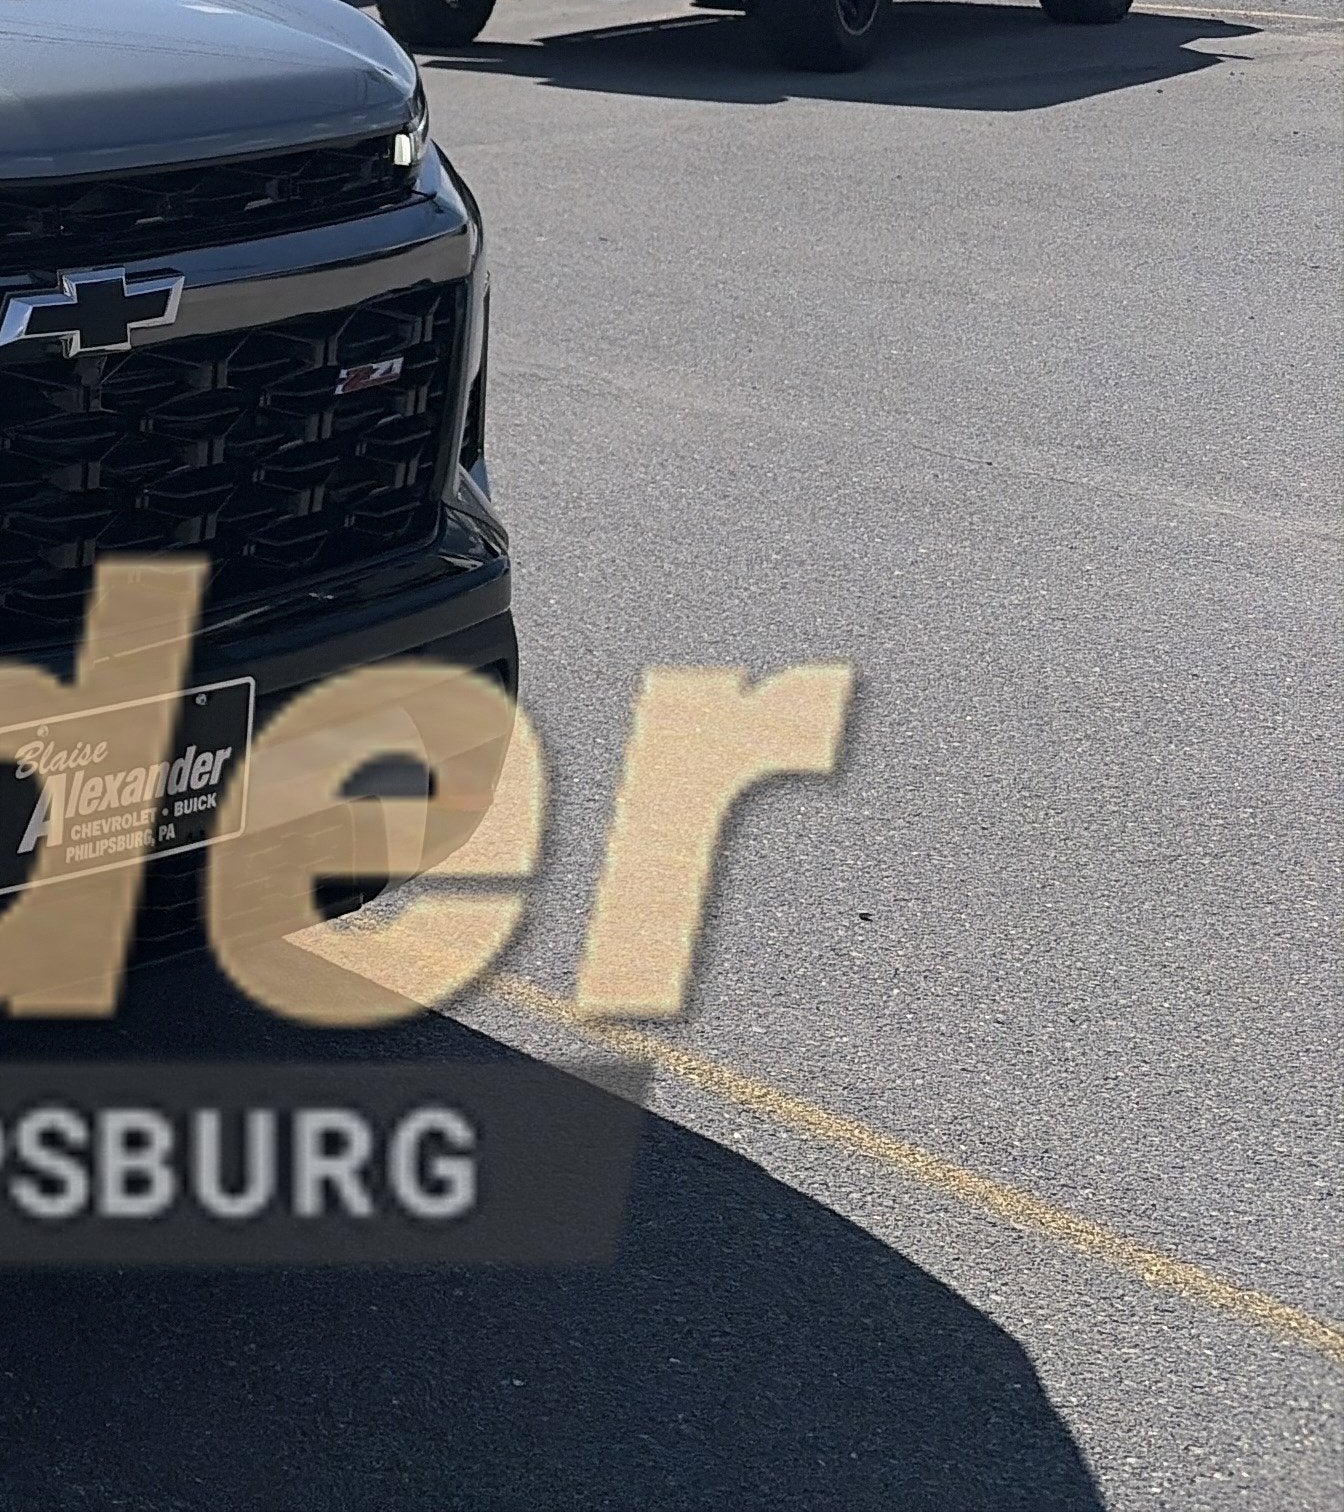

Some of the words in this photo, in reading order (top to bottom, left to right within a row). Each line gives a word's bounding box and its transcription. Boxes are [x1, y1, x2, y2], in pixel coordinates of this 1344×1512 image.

[14, 741, 108, 779] Blaise
[17, 744, 232, 854] Alexander
[70, 806, 158, 840] CHEVROLET
[174, 792, 217, 818] BUICK
[158, 823, 176, 840] PA
